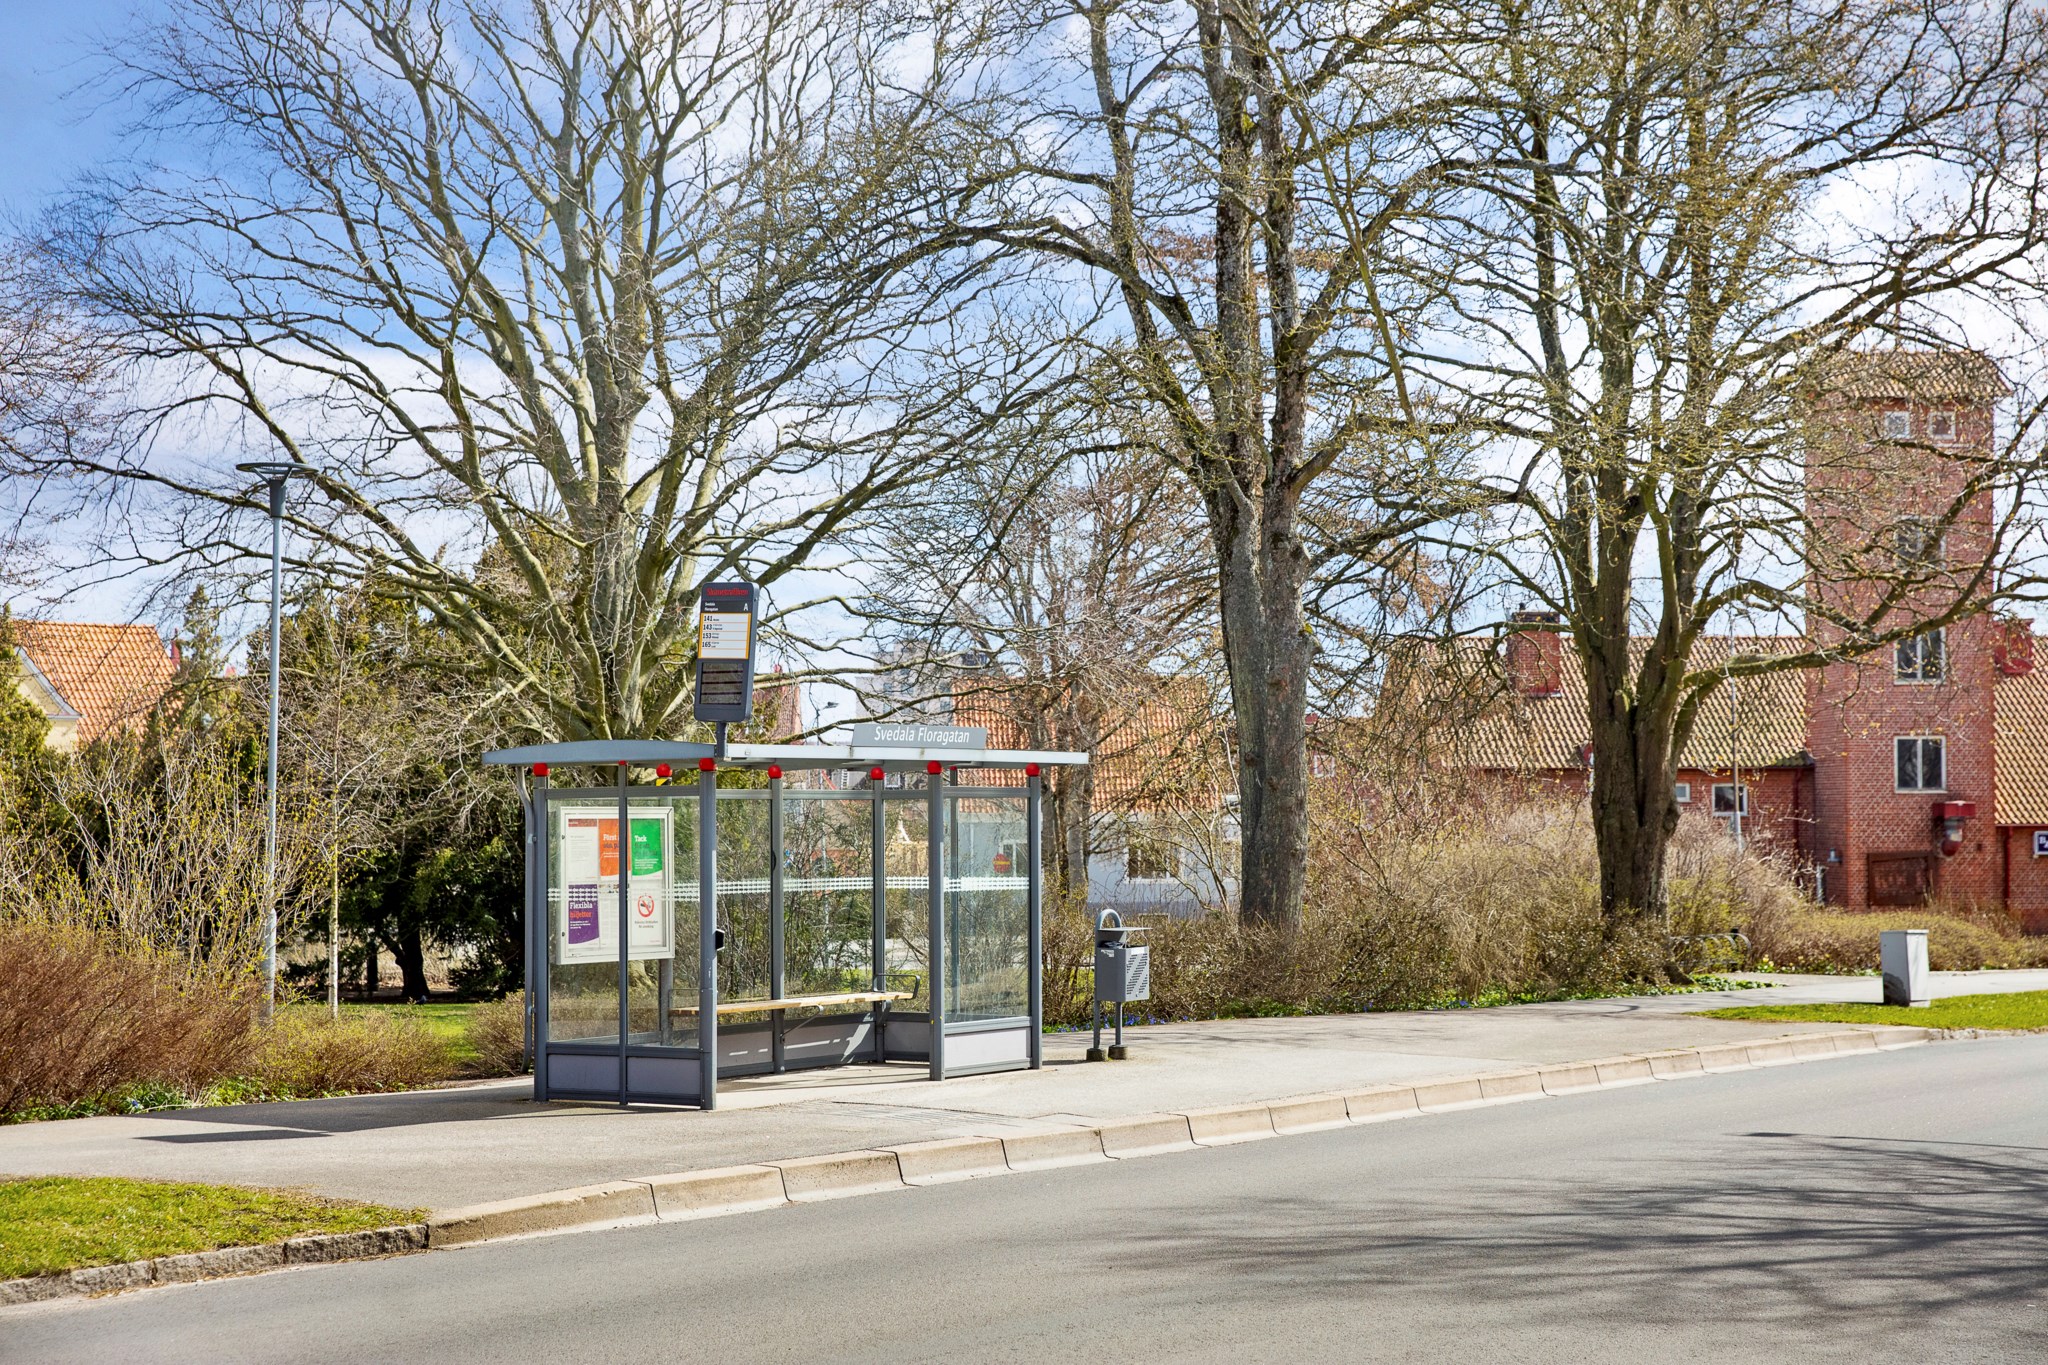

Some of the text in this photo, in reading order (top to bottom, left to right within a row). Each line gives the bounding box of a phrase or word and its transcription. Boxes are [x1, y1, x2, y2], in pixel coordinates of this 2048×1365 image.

[743, 603, 749, 611] A
[874, 726, 970, 746] Svedala Floragatan
